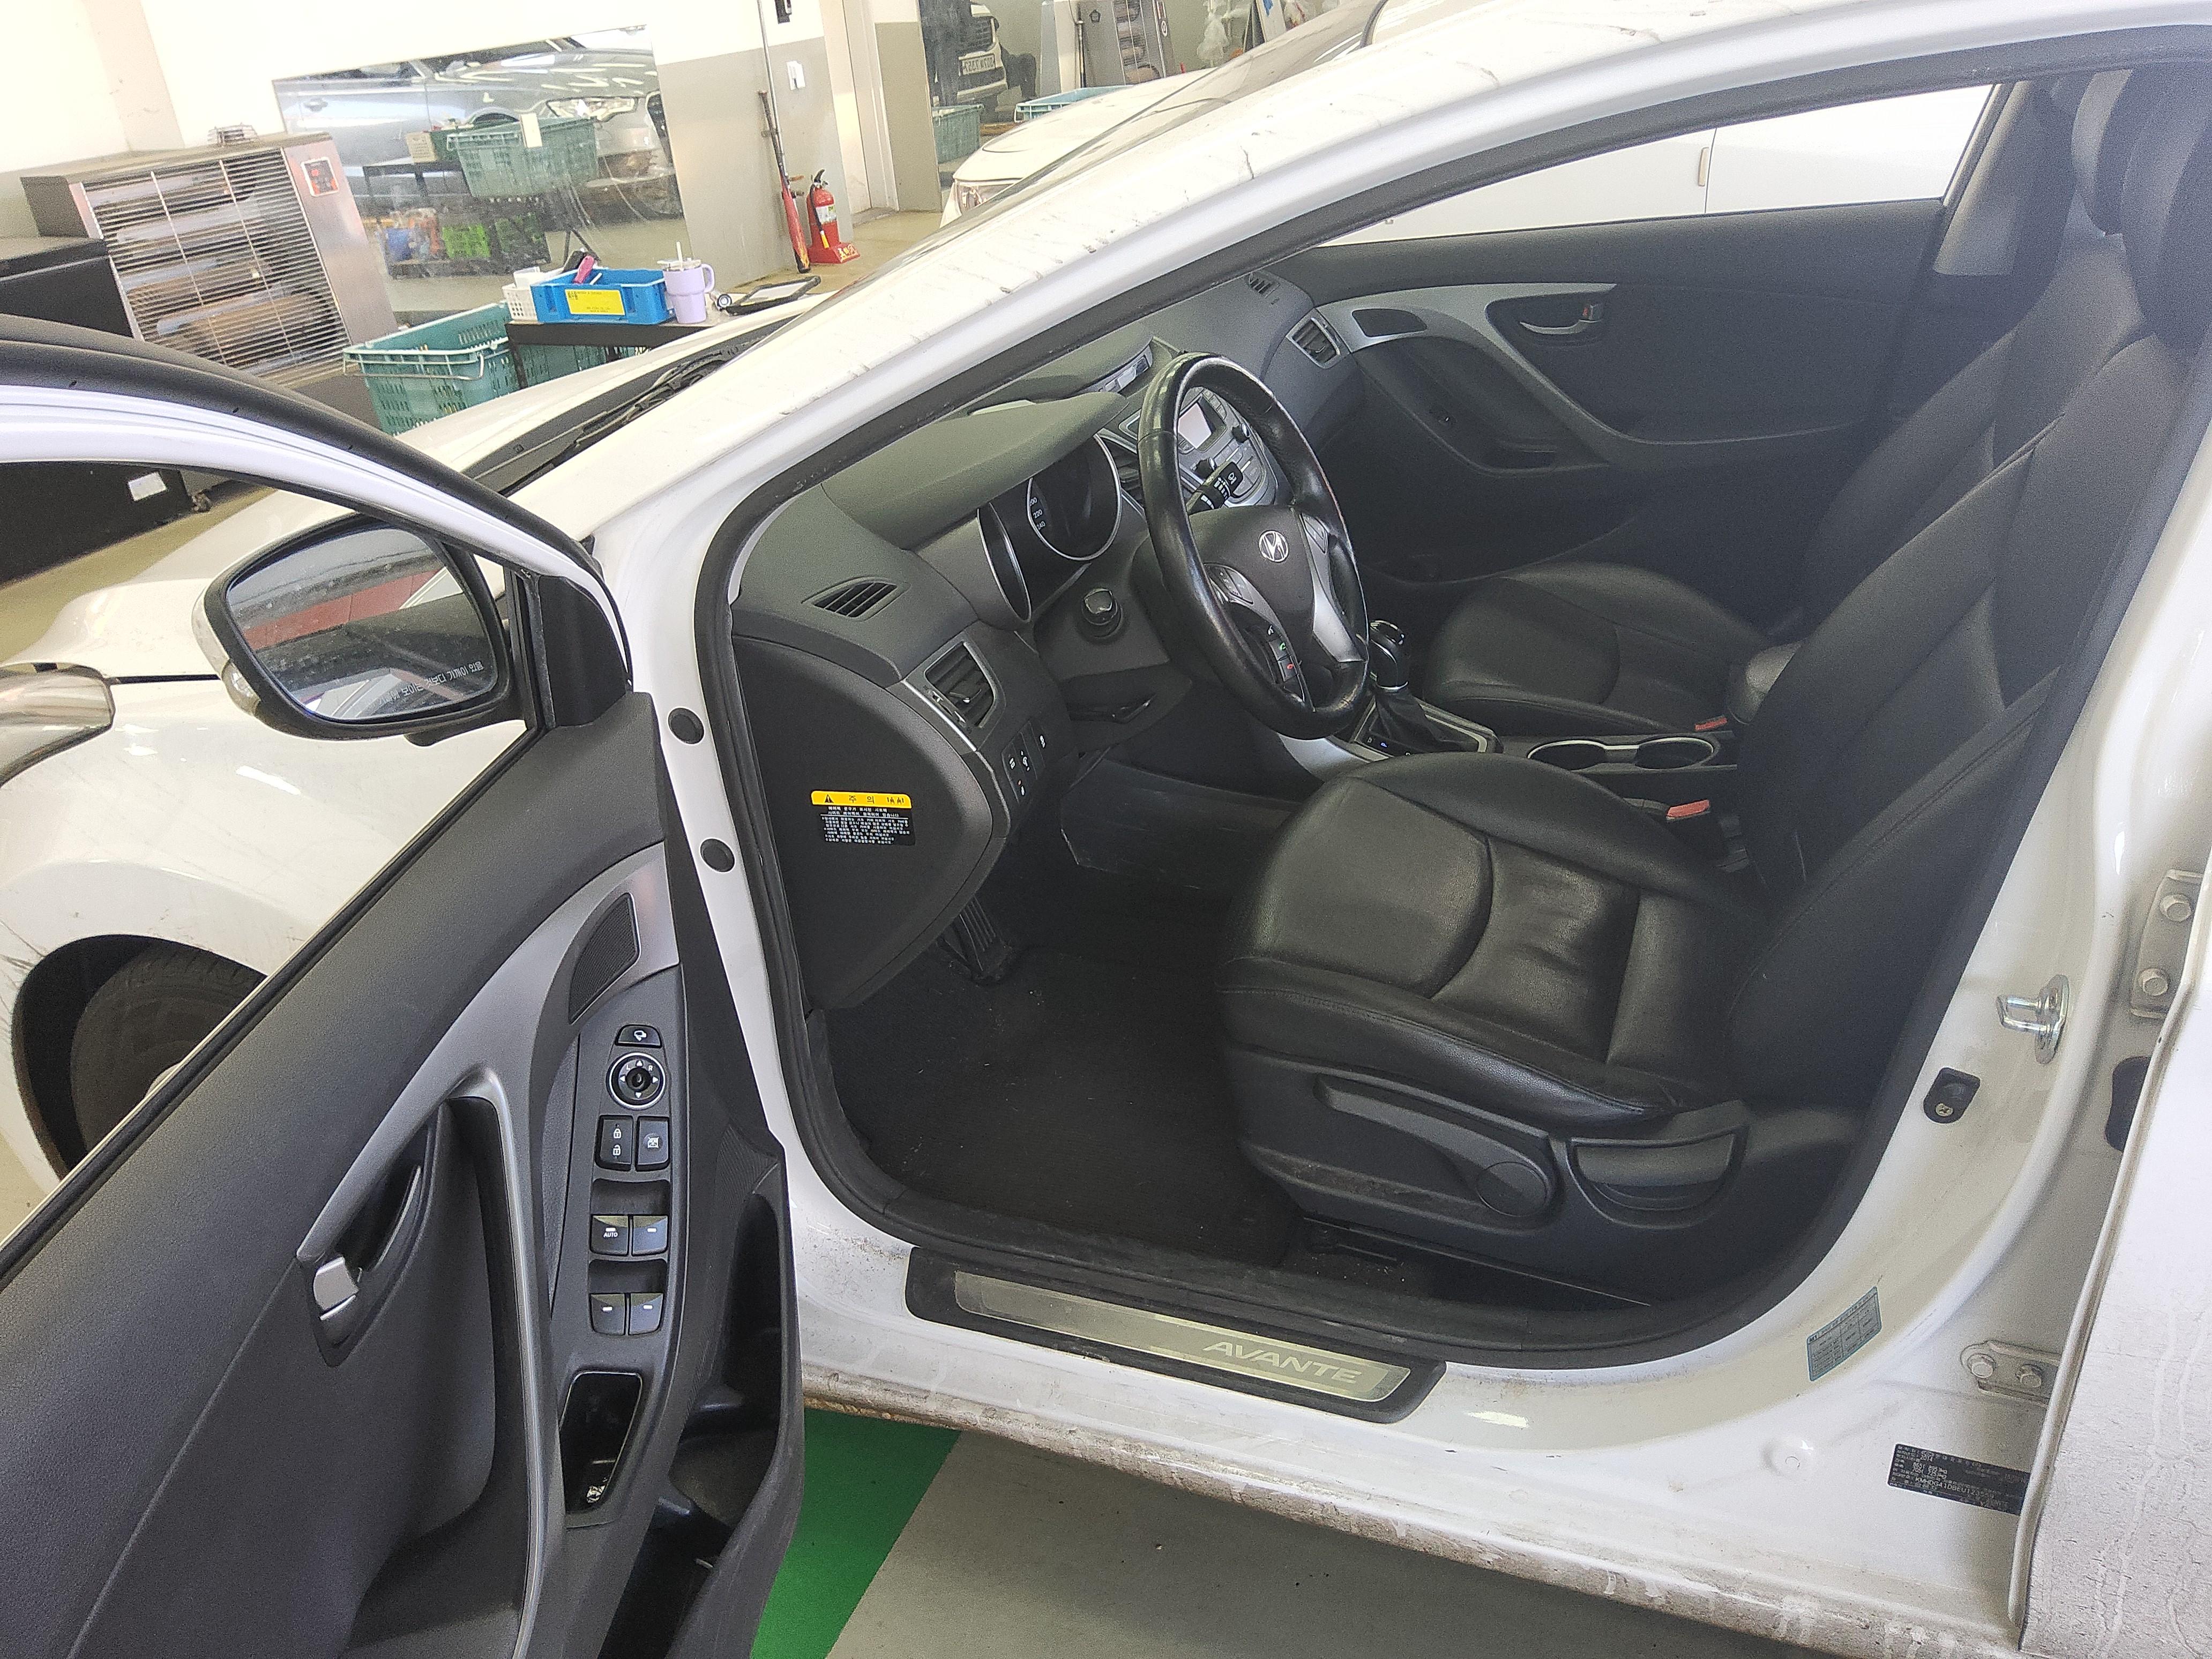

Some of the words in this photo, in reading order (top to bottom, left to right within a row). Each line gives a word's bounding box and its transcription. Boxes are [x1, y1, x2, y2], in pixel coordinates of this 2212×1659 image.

[1033, 510, 1042, 518] 220
[1037, 521, 1045, 529] 240
[469, 661, 484, 673] 있음
[1203, 1342, 1362, 1384] AVANTE
